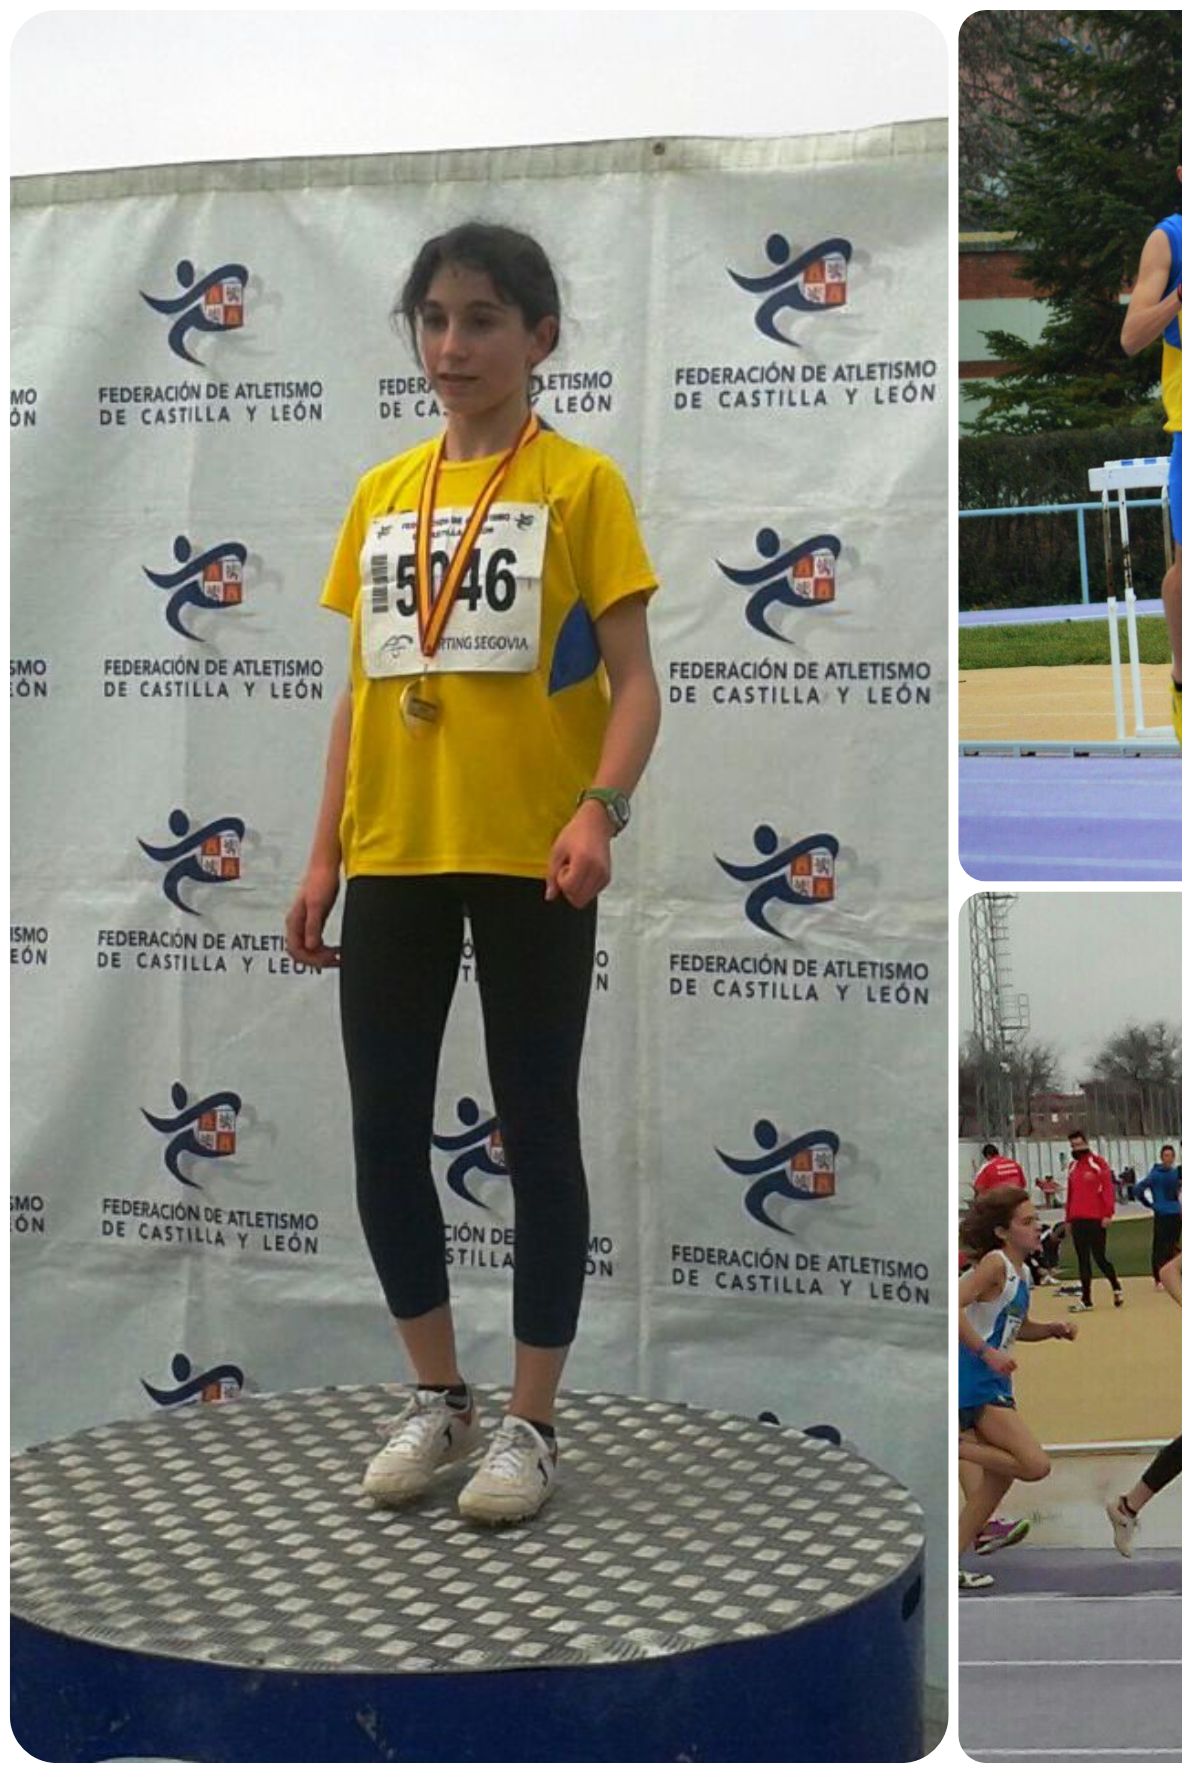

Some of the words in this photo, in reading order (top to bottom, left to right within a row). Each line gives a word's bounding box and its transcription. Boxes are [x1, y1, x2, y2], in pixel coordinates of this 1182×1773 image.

[532, 371, 612, 391] LETISMO
[675, 360, 795, 386] FEDERACIÓN
[802, 364, 826, 383] DE
[833, 359, 937, 382] ATLETISMO
[99, 380, 202, 405] FEDERACIÓN
[206, 382, 228, 400] DE
[234, 381, 323, 400] ATLETISMO
[555, 391, 611, 413] LEÓN
[674, 391, 701, 410] DE
[719, 388, 827, 408] CASTILLA
[846, 387, 857, 406] Y
[874, 380, 936, 402] LEÓN
[99, 409, 126, 427] DE
[141, 408, 230, 425] CASTILLA
[246, 405, 257, 421] Y
[270, 401, 323, 421] LEÓN
[380, 402, 401, 419] DE
[474, 635, 529, 651] SEGOVIA
[104, 654, 198, 677] FEDERACIÓN
[205, 660, 226, 676] DE
[233, 659, 323, 678] ATLETISMO
[669, 657, 787, 679] FEDERACIÓN
[794, 662, 818, 680] DE
[824, 661, 931, 681] ATLETISMO
[104, 681, 126, 698] DE
[140, 681, 228, 698] CASTILLA
[245, 682, 255, 698] Y
[270, 677, 322, 700] LEÓN
[669, 686, 696, 703] DE
[713, 685, 820, 705] CASTILLA
[837, 686, 849, 704] Y
[868, 681, 931, 705] LEÓN
[98, 929, 197, 949] FEDERACIÓN
[203, 934, 225, 950] DE
[97, 952, 121, 969] DE
[137, 952, 226, 972] CASTILLA
[242, 957, 252, 974] Y
[669, 953, 787, 976] FEDERACIÓN
[793, 959, 817, 977] DE
[823, 959, 929, 981] ATLETISMO
[669, 978, 696, 996] DE
[713, 979, 819, 1001] CASTILLA
[837, 985, 848, 1002] Y
[867, 982, 929, 1005] LEÓN
[102, 1198, 199, 1222] FEDERACIÓN
[204, 1207, 222, 1225] DE
[227, 1210, 318, 1231] ATLETISMO
[102, 1220, 125, 1238] DE
[138, 1223, 225, 1248] CASTILLA
[237, 1233, 249, 1250] Y
[263, 1232, 318, 1255] LEÓN
[491, 1228, 515, 1246] DE
[445, 1247, 514, 1270] STILLA
[671, 1244, 789, 1270] FEDERACIÓN
[796, 1253, 820, 1273] DE
[827, 1254, 929, 1282] ATLETISMO
[672, 1267, 699, 1287] DE
[715, 1271, 822, 1296] CASTILLA
[840, 1278, 852, 1296] Y
[870, 1280, 929, 1305] LEÓN
